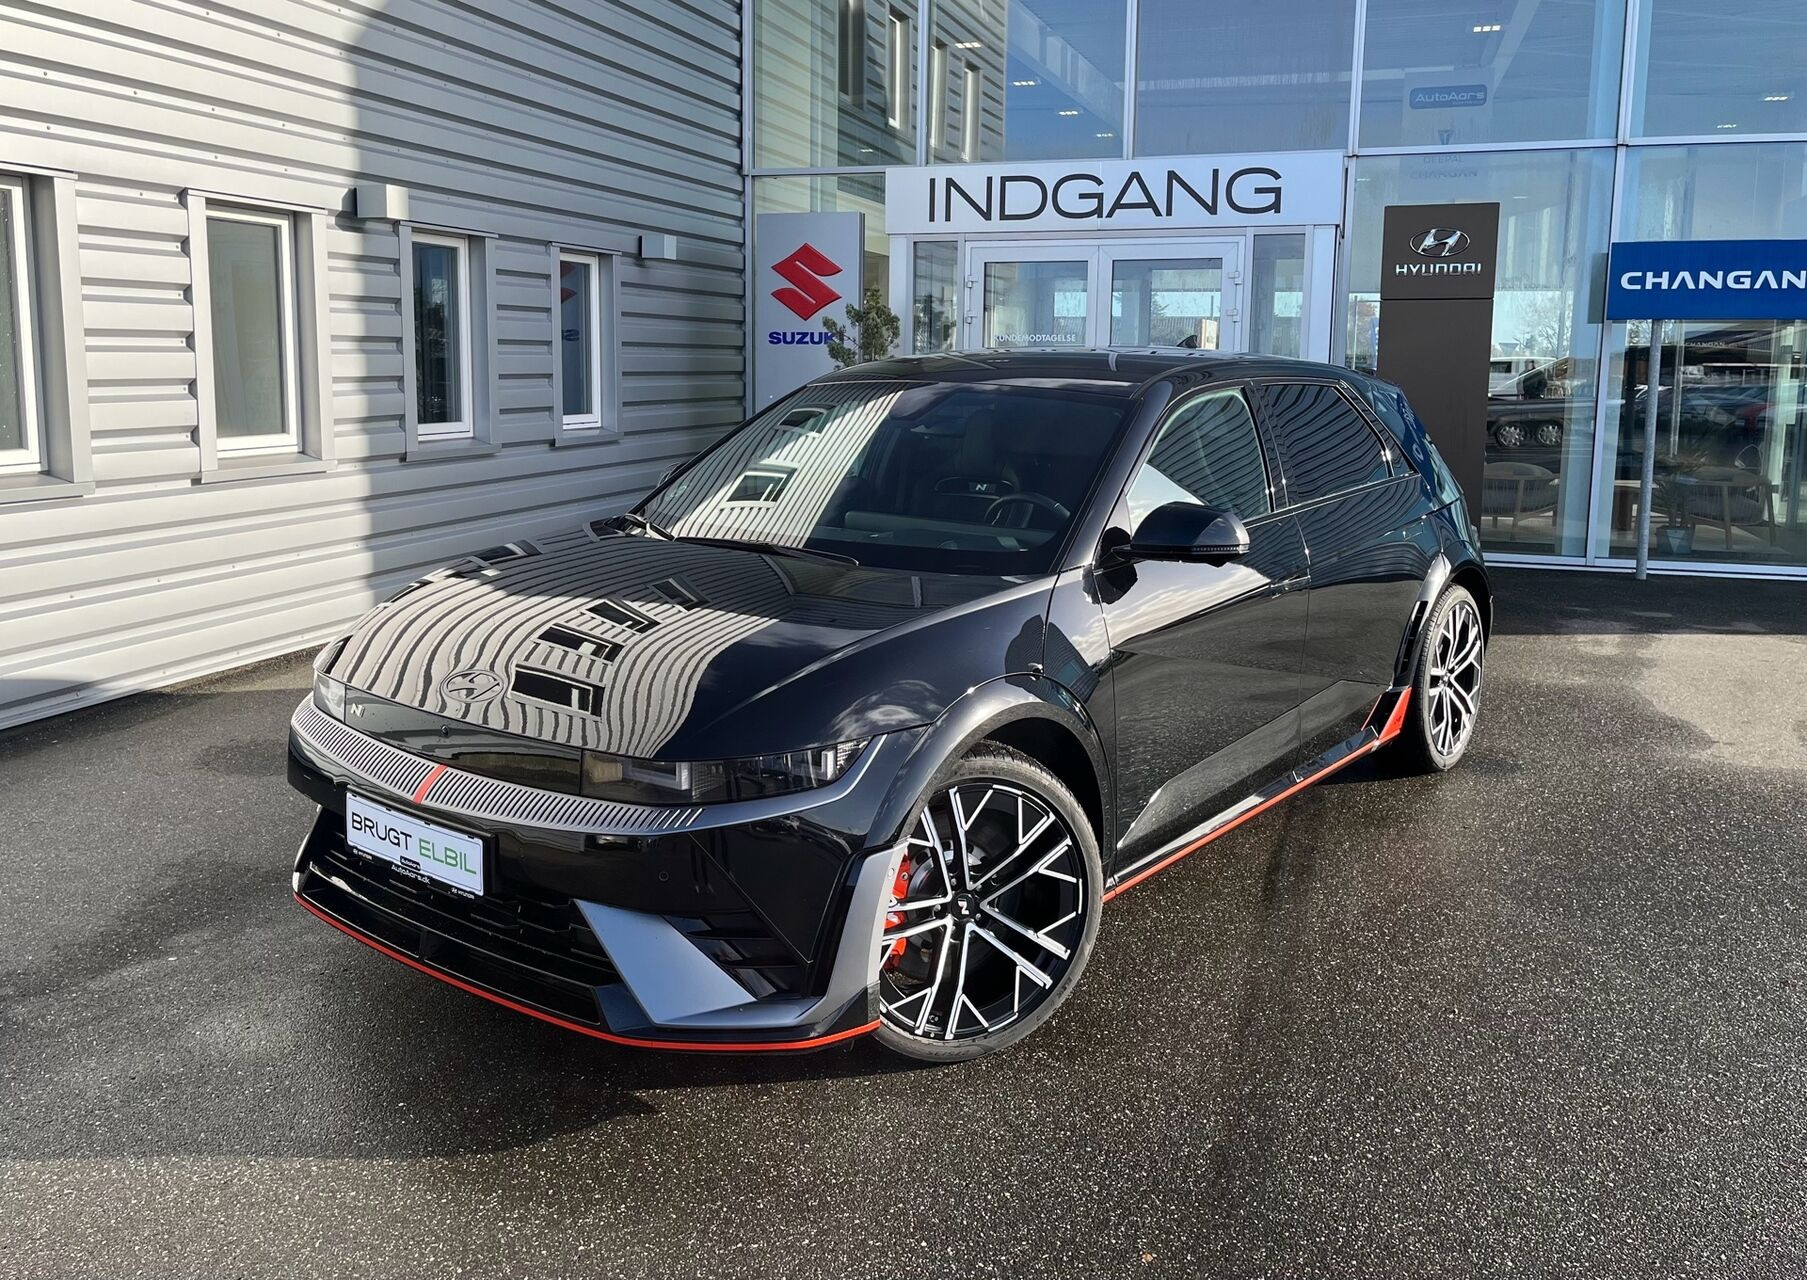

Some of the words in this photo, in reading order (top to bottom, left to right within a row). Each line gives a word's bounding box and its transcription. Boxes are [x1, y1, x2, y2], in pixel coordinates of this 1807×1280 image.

[1415, 91, 1485, 103] AutoAars
[929, 167, 1282, 222] INDGANG
[1395, 263, 1481, 276] HYUNDAI
[1620, 270, 1807, 290] CHANGAN
[352, 811, 412, 850] BRUGT
[419, 838, 477, 875] ELBIL
